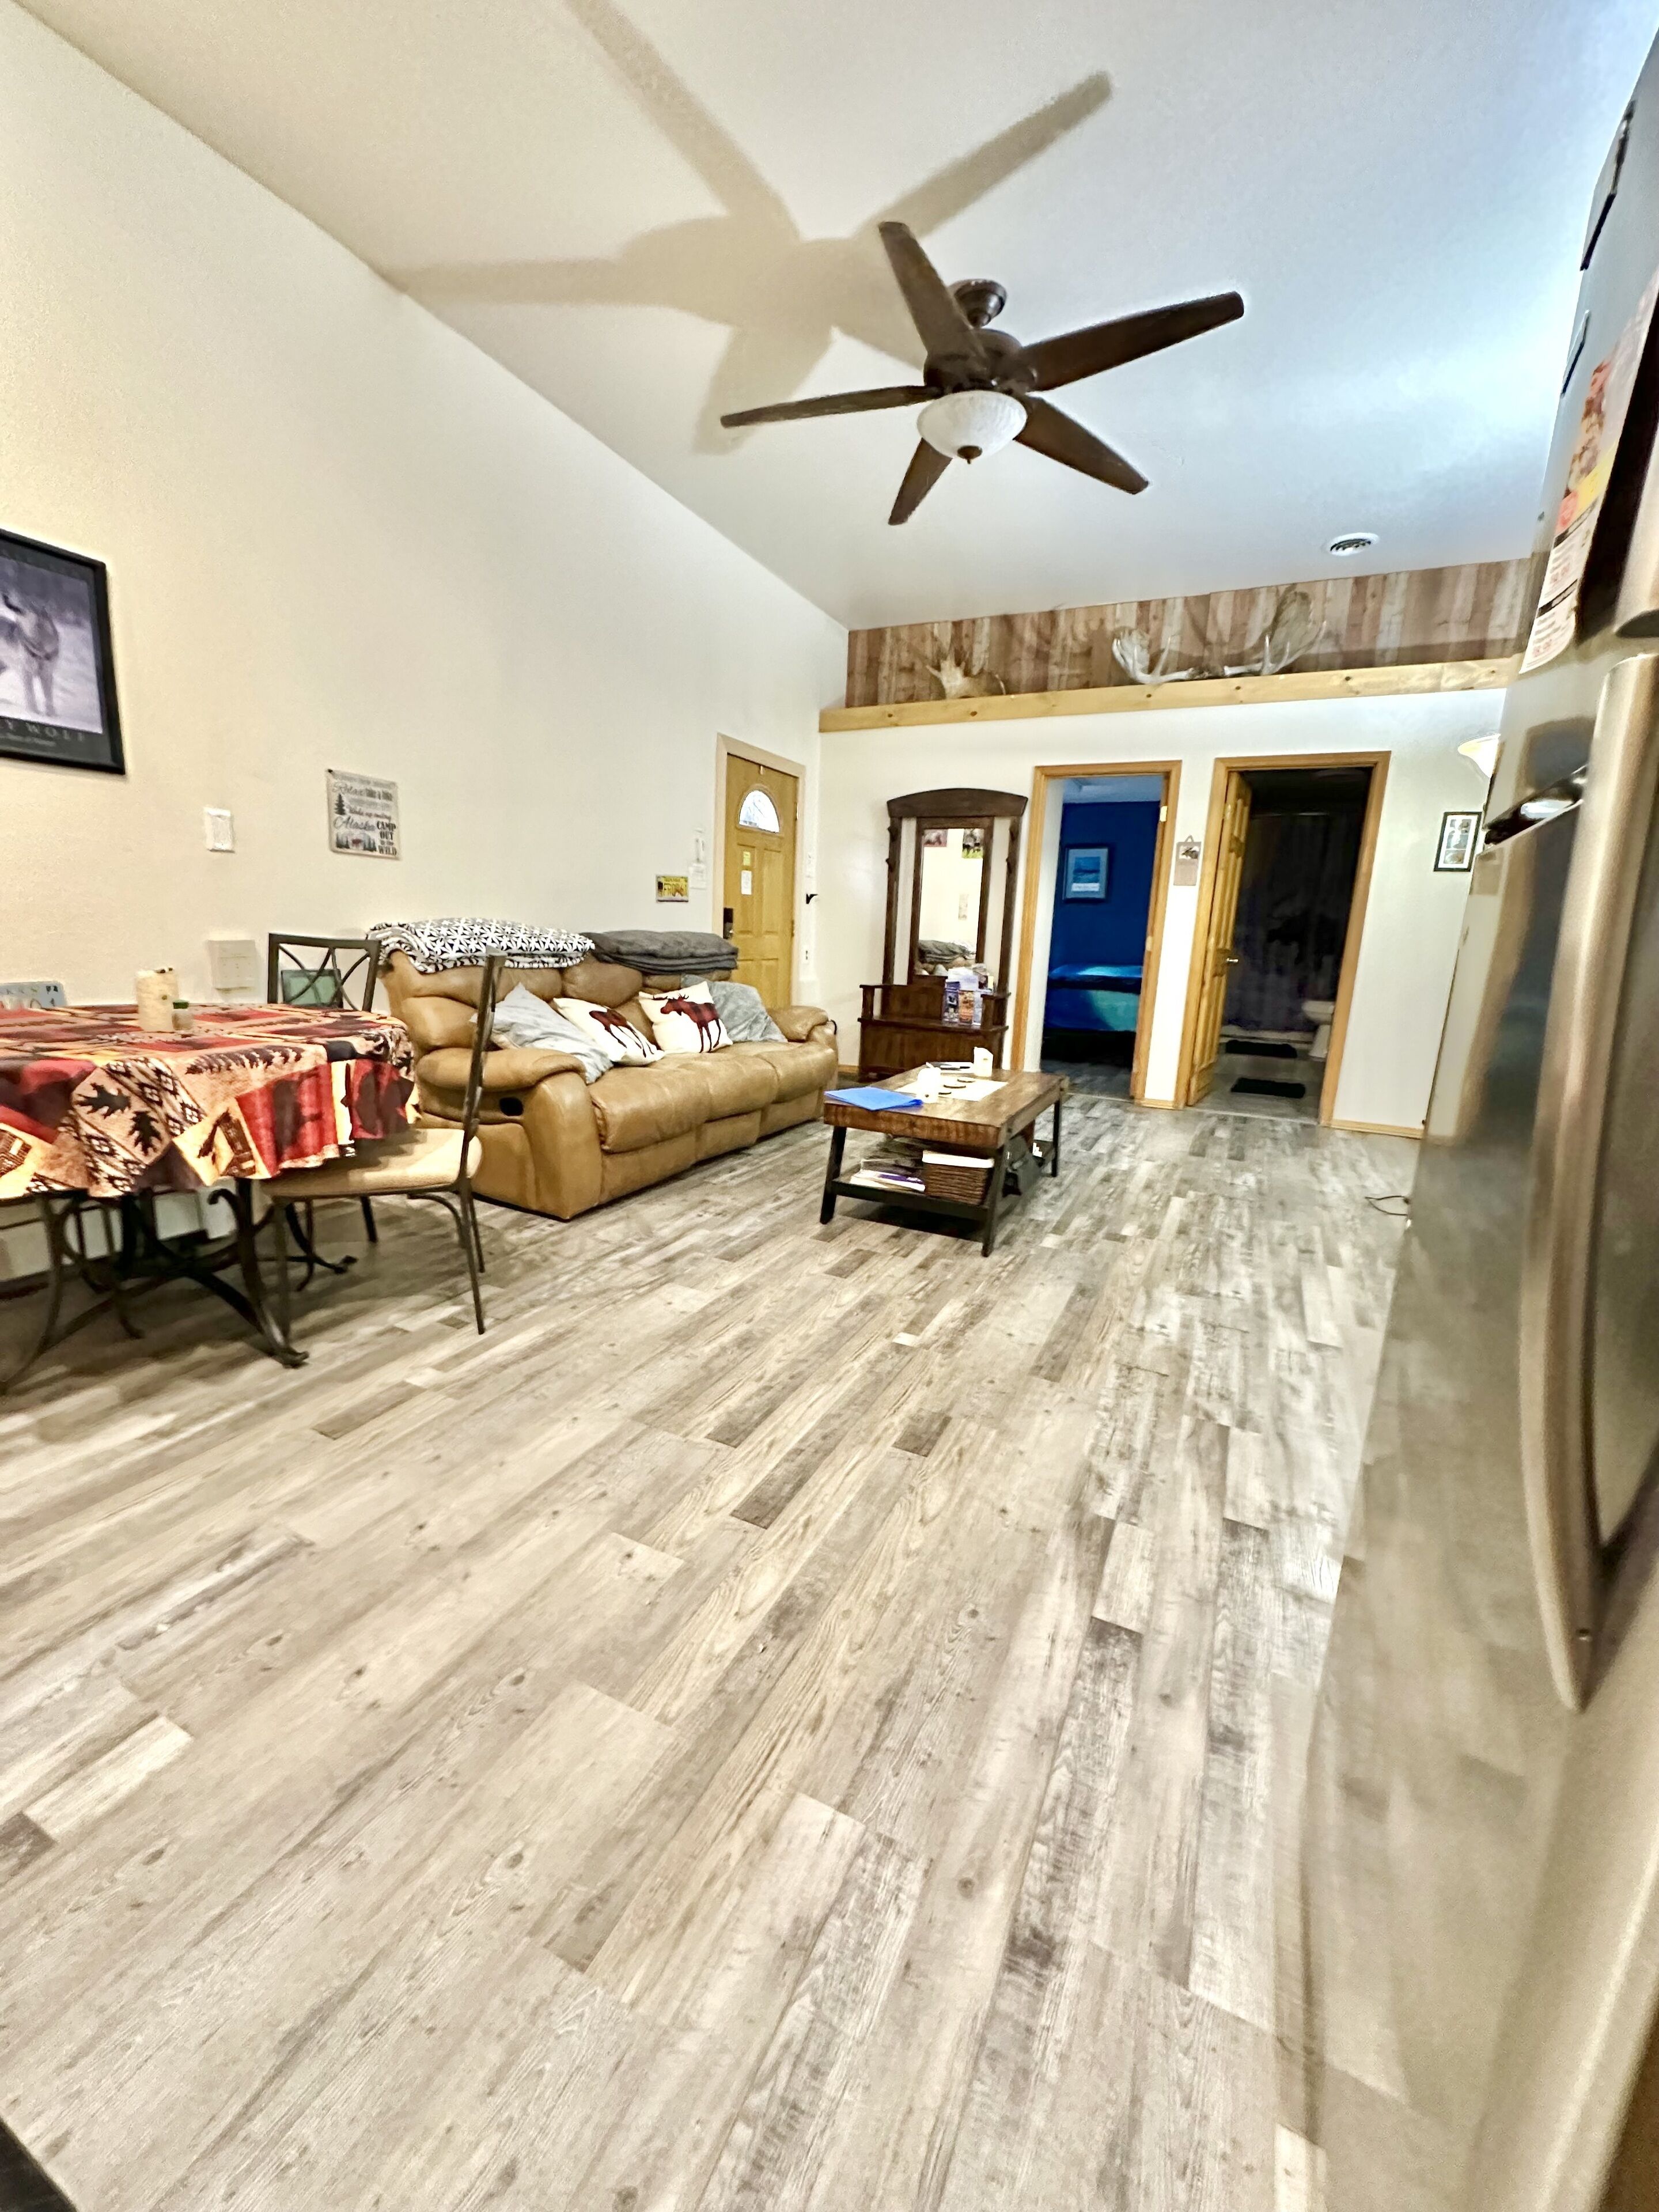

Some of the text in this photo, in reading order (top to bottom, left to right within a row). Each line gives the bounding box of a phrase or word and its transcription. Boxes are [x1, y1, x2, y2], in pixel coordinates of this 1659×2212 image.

[333, 816, 376, 831] Alaska
[377, 820, 396, 832] CAMP
[380, 831, 394, 840] OUT
[378, 845, 397, 855] WILD
